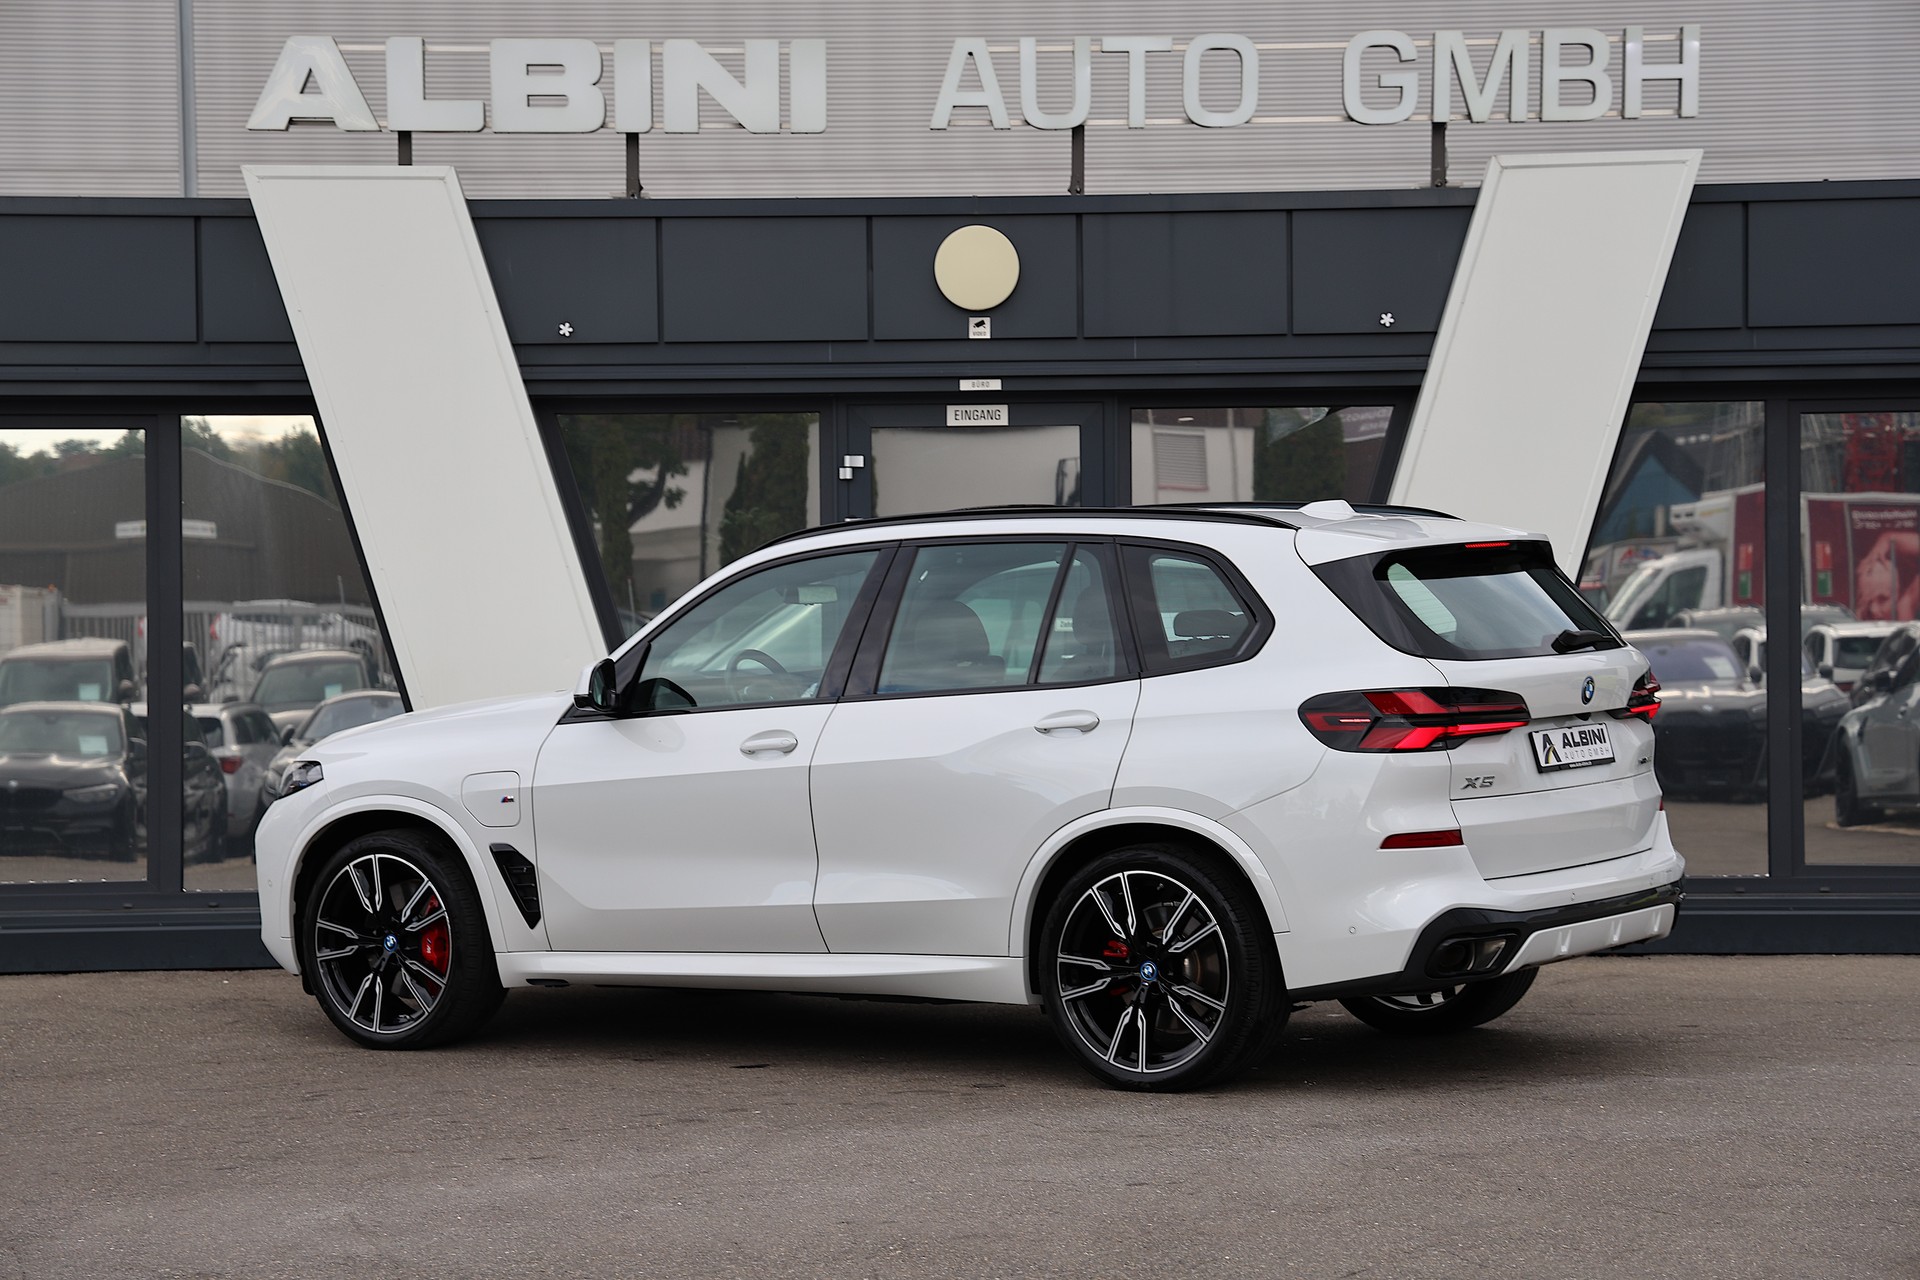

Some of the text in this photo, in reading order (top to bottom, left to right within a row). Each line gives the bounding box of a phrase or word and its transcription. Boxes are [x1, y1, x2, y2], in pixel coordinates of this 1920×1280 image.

[245, 25, 1702, 134] ALBINI AUTO GMBH
[954, 409, 1002, 421] EINGANG
[1562, 728, 1607, 749] ALBINI
[1564, 747, 1610, 760] AUTO GMBH
[1460, 775, 1496, 790] X5
